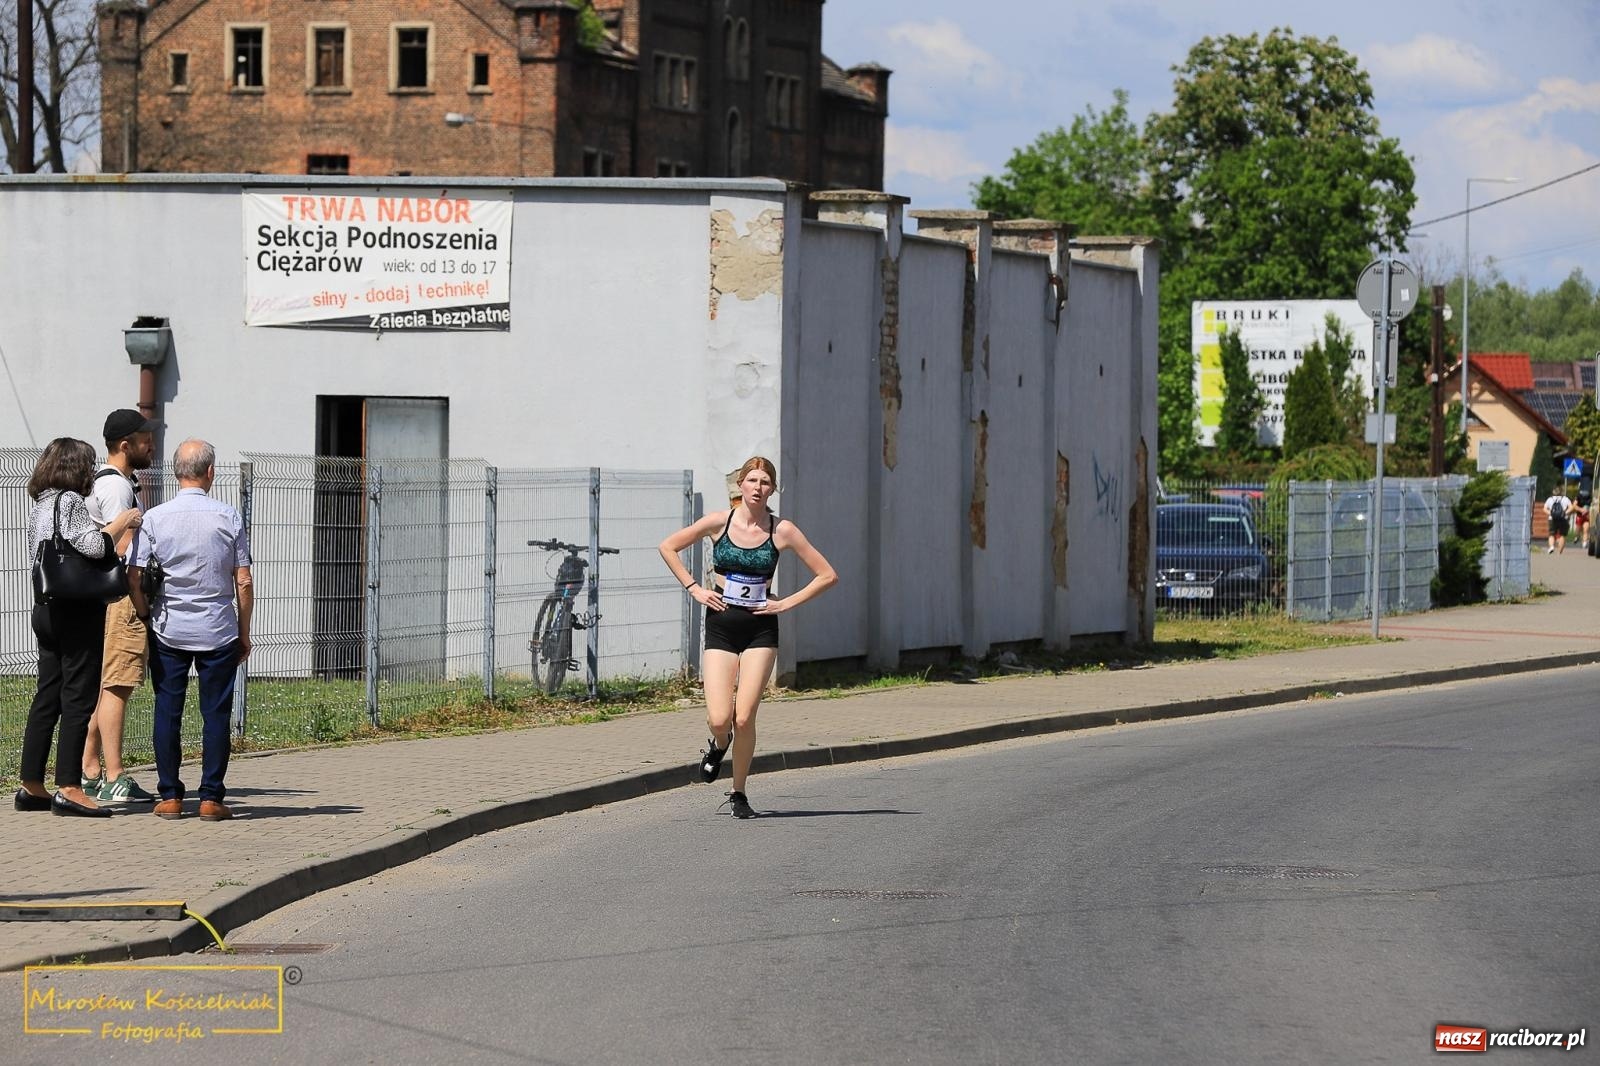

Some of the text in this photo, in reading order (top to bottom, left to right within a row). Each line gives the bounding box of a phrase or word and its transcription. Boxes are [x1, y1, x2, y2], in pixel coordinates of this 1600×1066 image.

[282, 189, 473, 223] TRWA NABÓR
[257, 224, 497, 253] Sekcja Podnoszenia
[256, 249, 363, 277] Ciężarów
[383, 259, 497, 275] wiek: od 13 do 17
[313, 291, 348, 309] silny
[366, 284, 410, 303] dodaj
[432, 306, 511, 328] bezpłatne
[740, 585, 751, 599] 2
